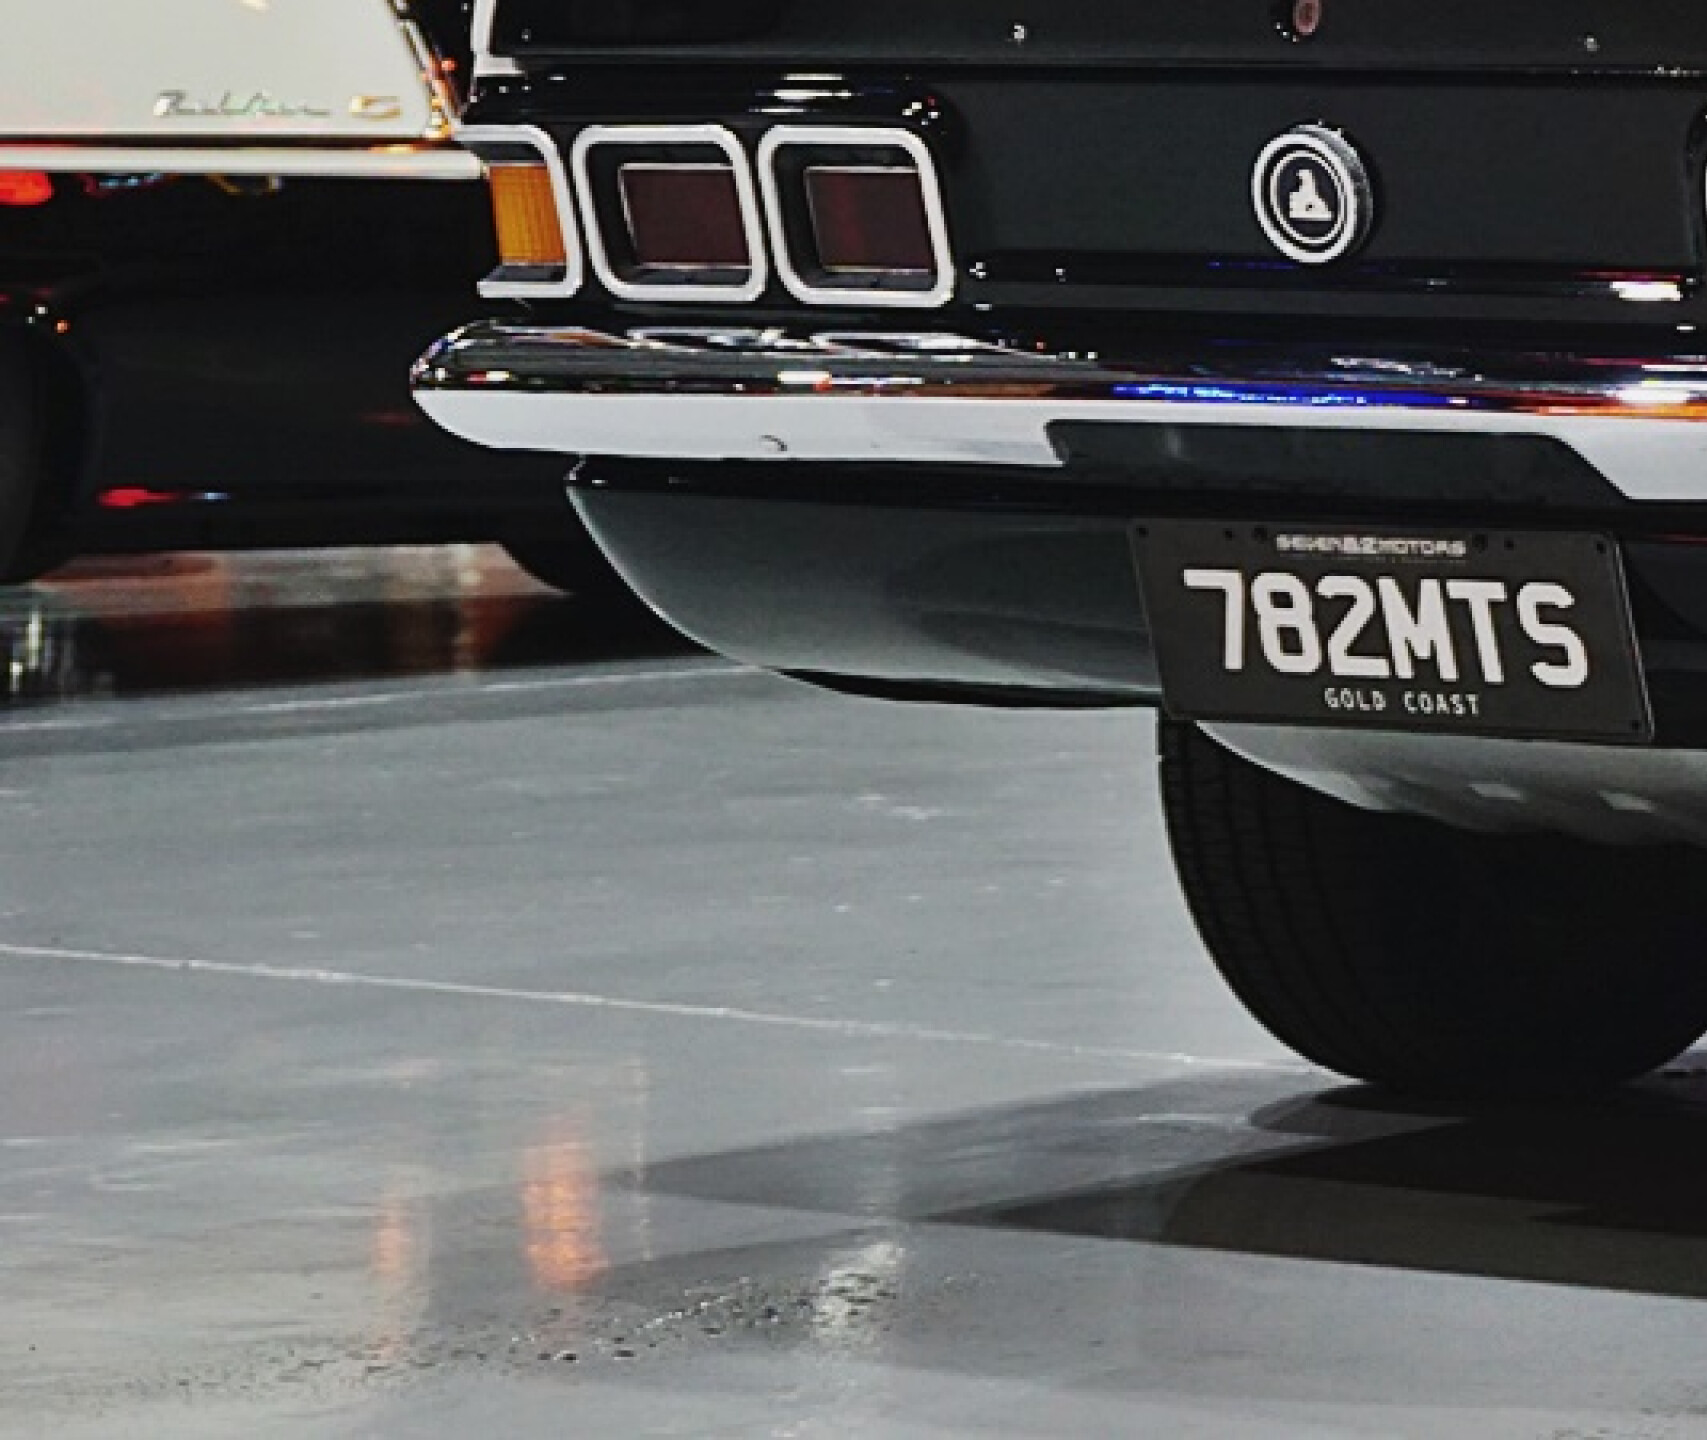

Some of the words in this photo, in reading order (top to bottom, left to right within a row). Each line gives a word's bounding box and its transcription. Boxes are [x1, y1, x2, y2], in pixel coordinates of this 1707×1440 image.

[1183, 568, 1589, 688] 782MTS
[1324, 687, 1387, 711] GOLD
[1403, 691, 1481, 715] COAST
